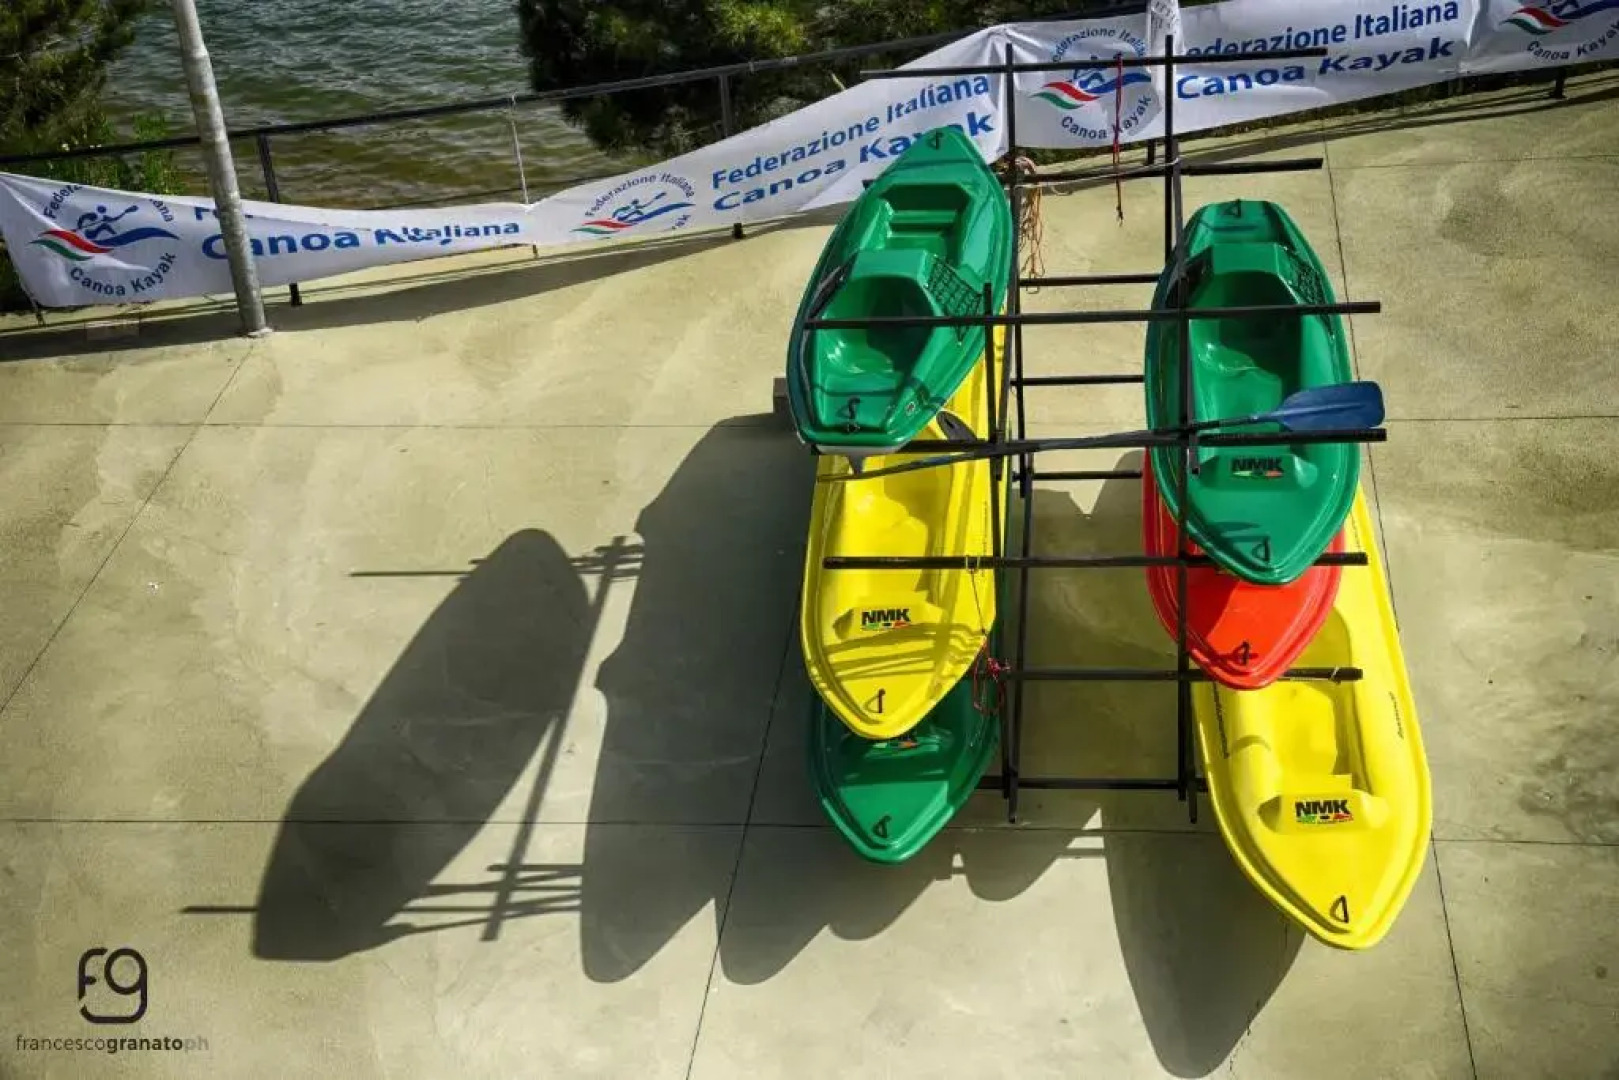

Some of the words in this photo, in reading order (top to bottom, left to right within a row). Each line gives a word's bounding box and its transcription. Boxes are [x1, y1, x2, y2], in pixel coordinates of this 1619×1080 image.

[1184, 24, 1347, 57] ederazione
[1355, 0, 1459, 39] Italiana
[1526, 40, 1571, 60] Canoa
[1176, 65, 1305, 99] Canoa
[1318, 36, 1455, 75] Kayak
[712, 116, 880, 189] Federazione
[886, 74, 990, 123] Italiana
[1061, 115, 1108, 140] Canoa
[712, 159, 847, 211] Canoa
[858, 111, 996, 164] Kak
[70, 266, 126, 296] Canoa
[130, 252, 176, 293] Kayak
[1231, 456, 1284, 474] NMK
[861, 607, 911, 626] NMK
[1294, 798, 1351, 818] NMK
